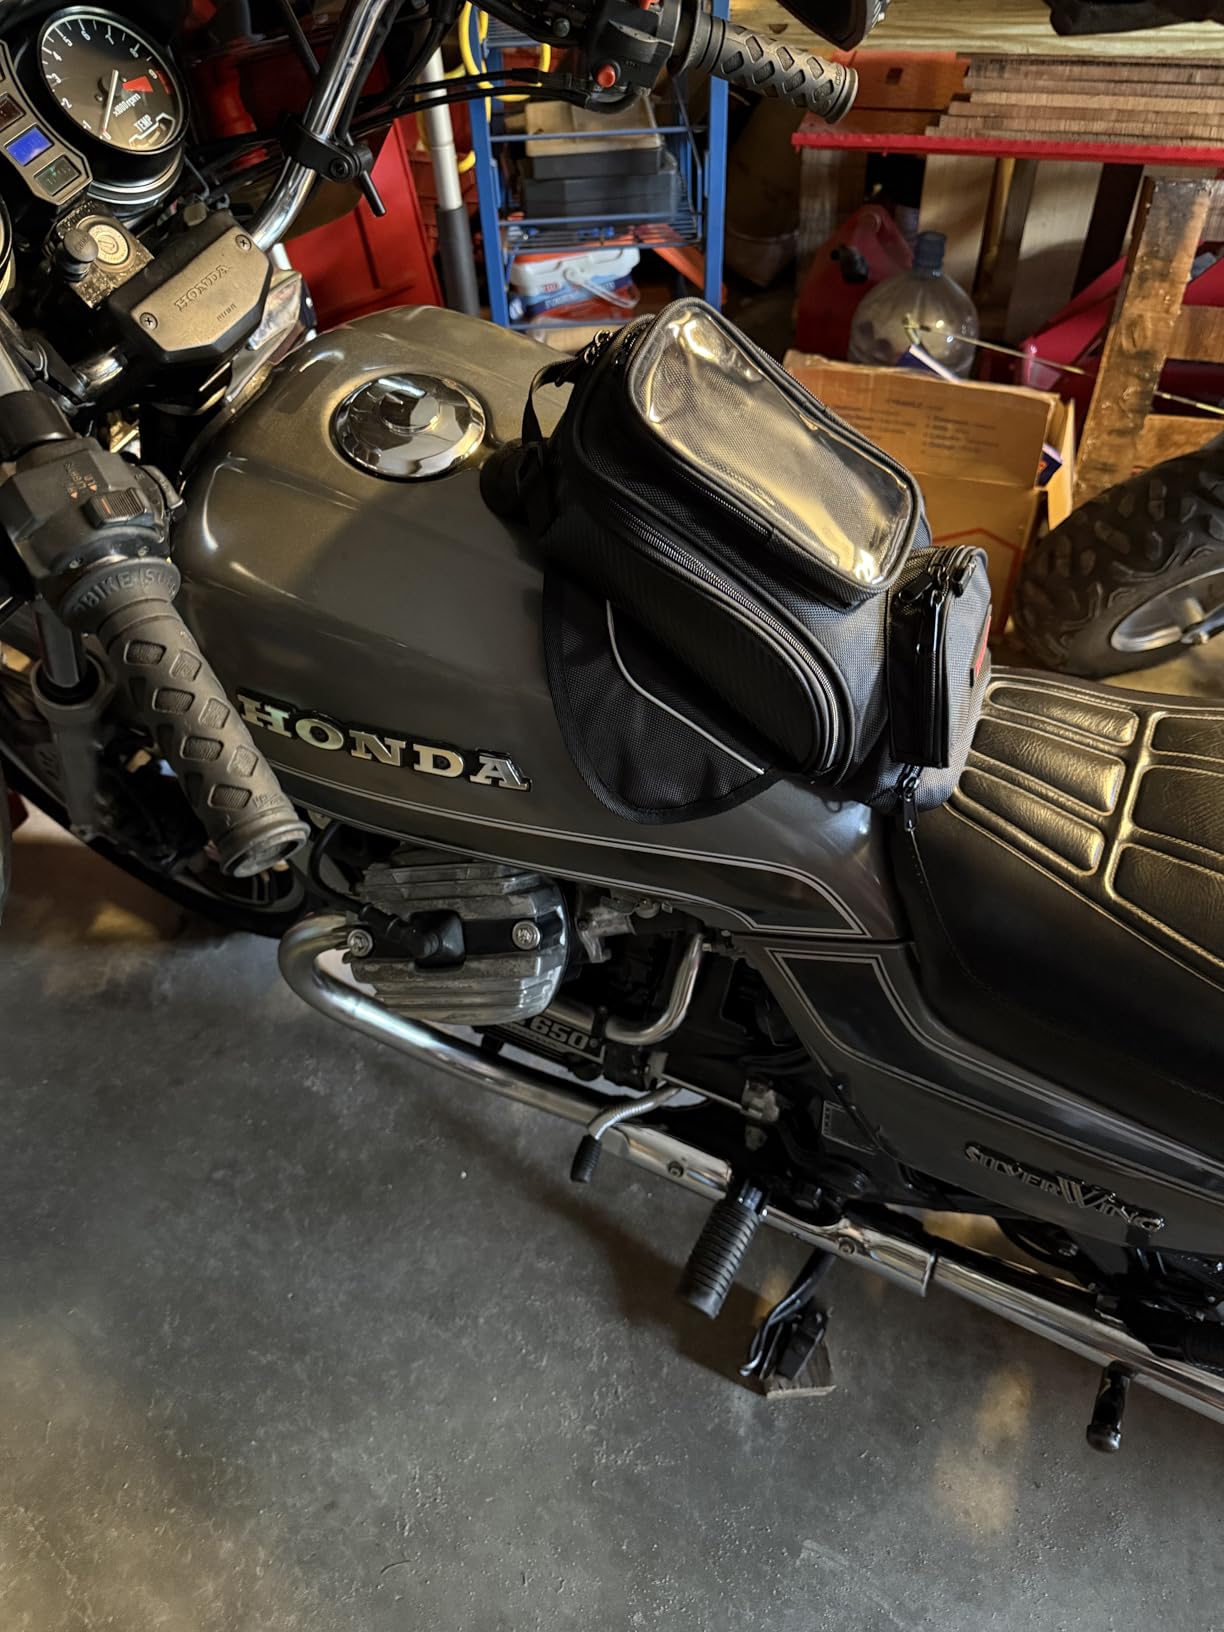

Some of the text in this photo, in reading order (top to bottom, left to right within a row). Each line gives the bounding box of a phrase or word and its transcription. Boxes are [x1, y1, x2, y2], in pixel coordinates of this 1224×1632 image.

[133, 114, 153, 133] TEMP
[174, 263, 232, 312] HONDA
[236, 689, 532, 792] HONDA
[529, 1015, 589, 1051] 650
